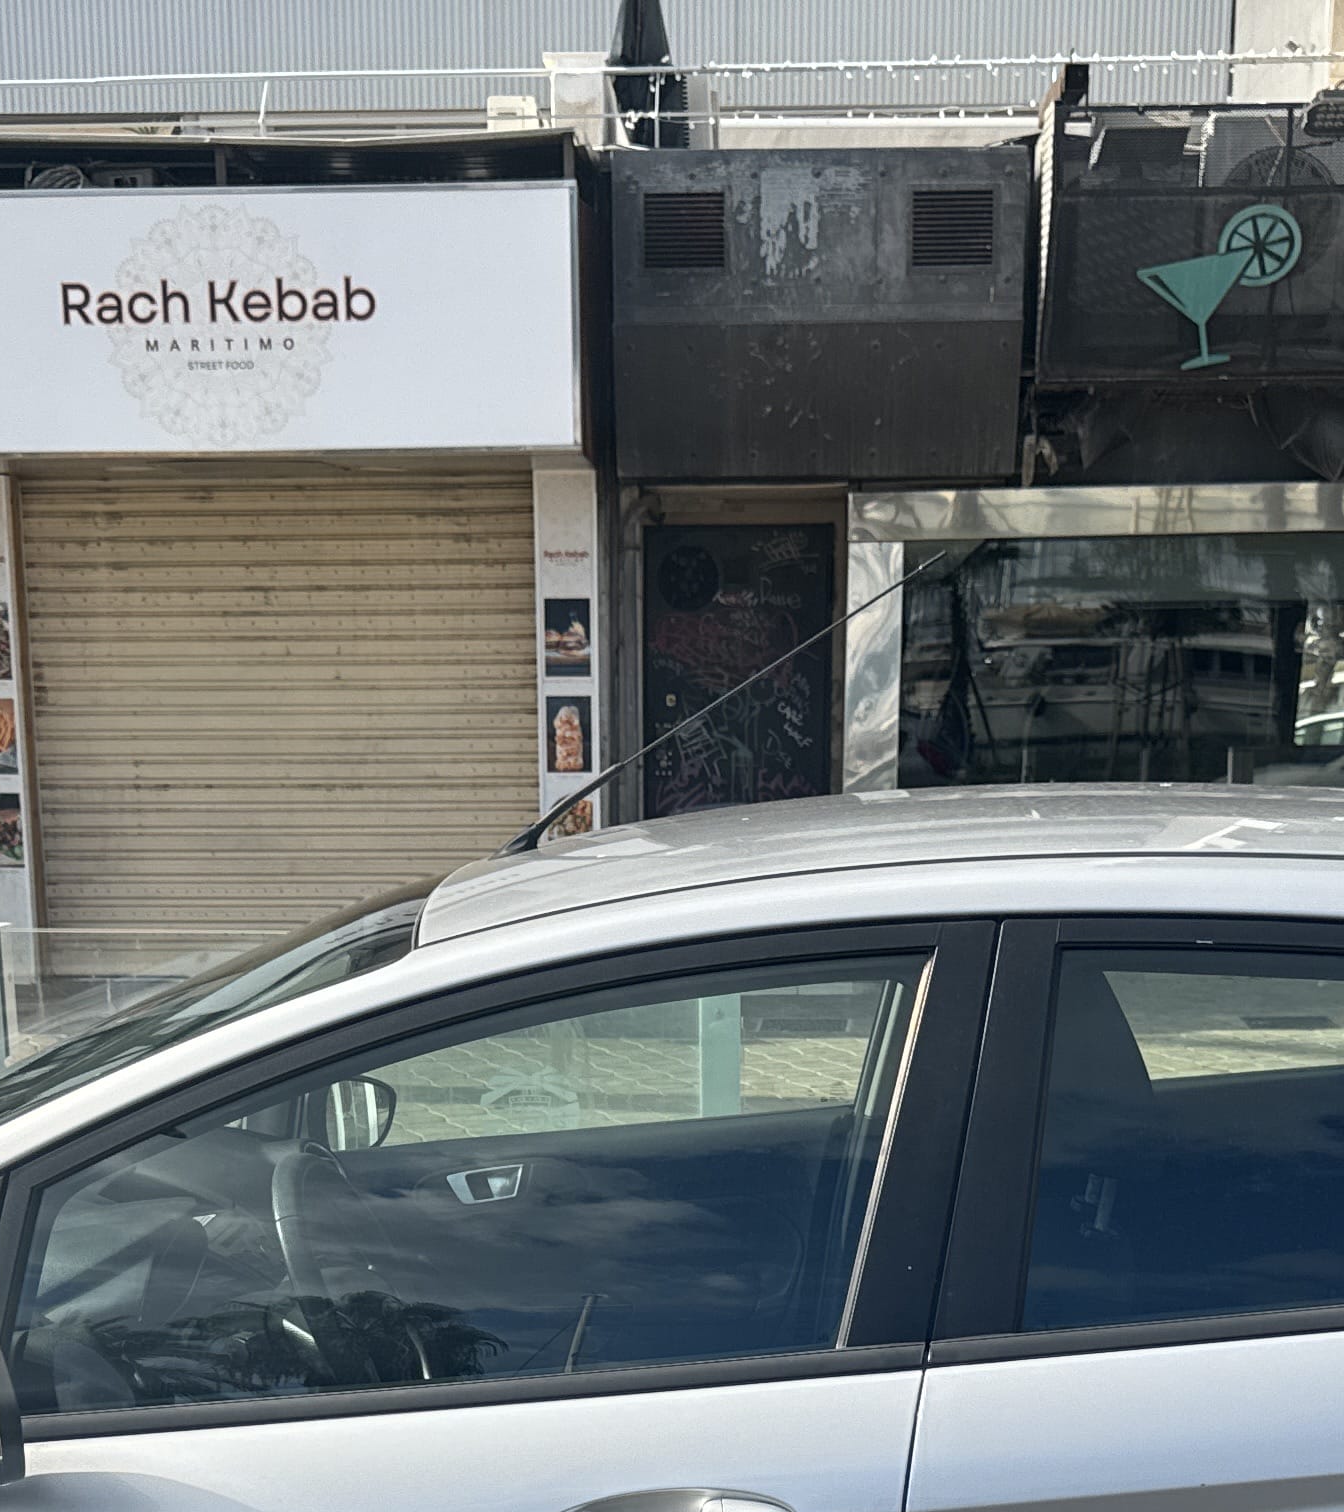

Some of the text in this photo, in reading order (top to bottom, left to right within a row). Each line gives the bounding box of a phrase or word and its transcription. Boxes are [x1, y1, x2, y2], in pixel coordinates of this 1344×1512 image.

[60, 275, 377, 326] Rach Kebab
[145, 337, 296, 352] MARITIMO
[187, 360, 254, 371] STREET FOOD
